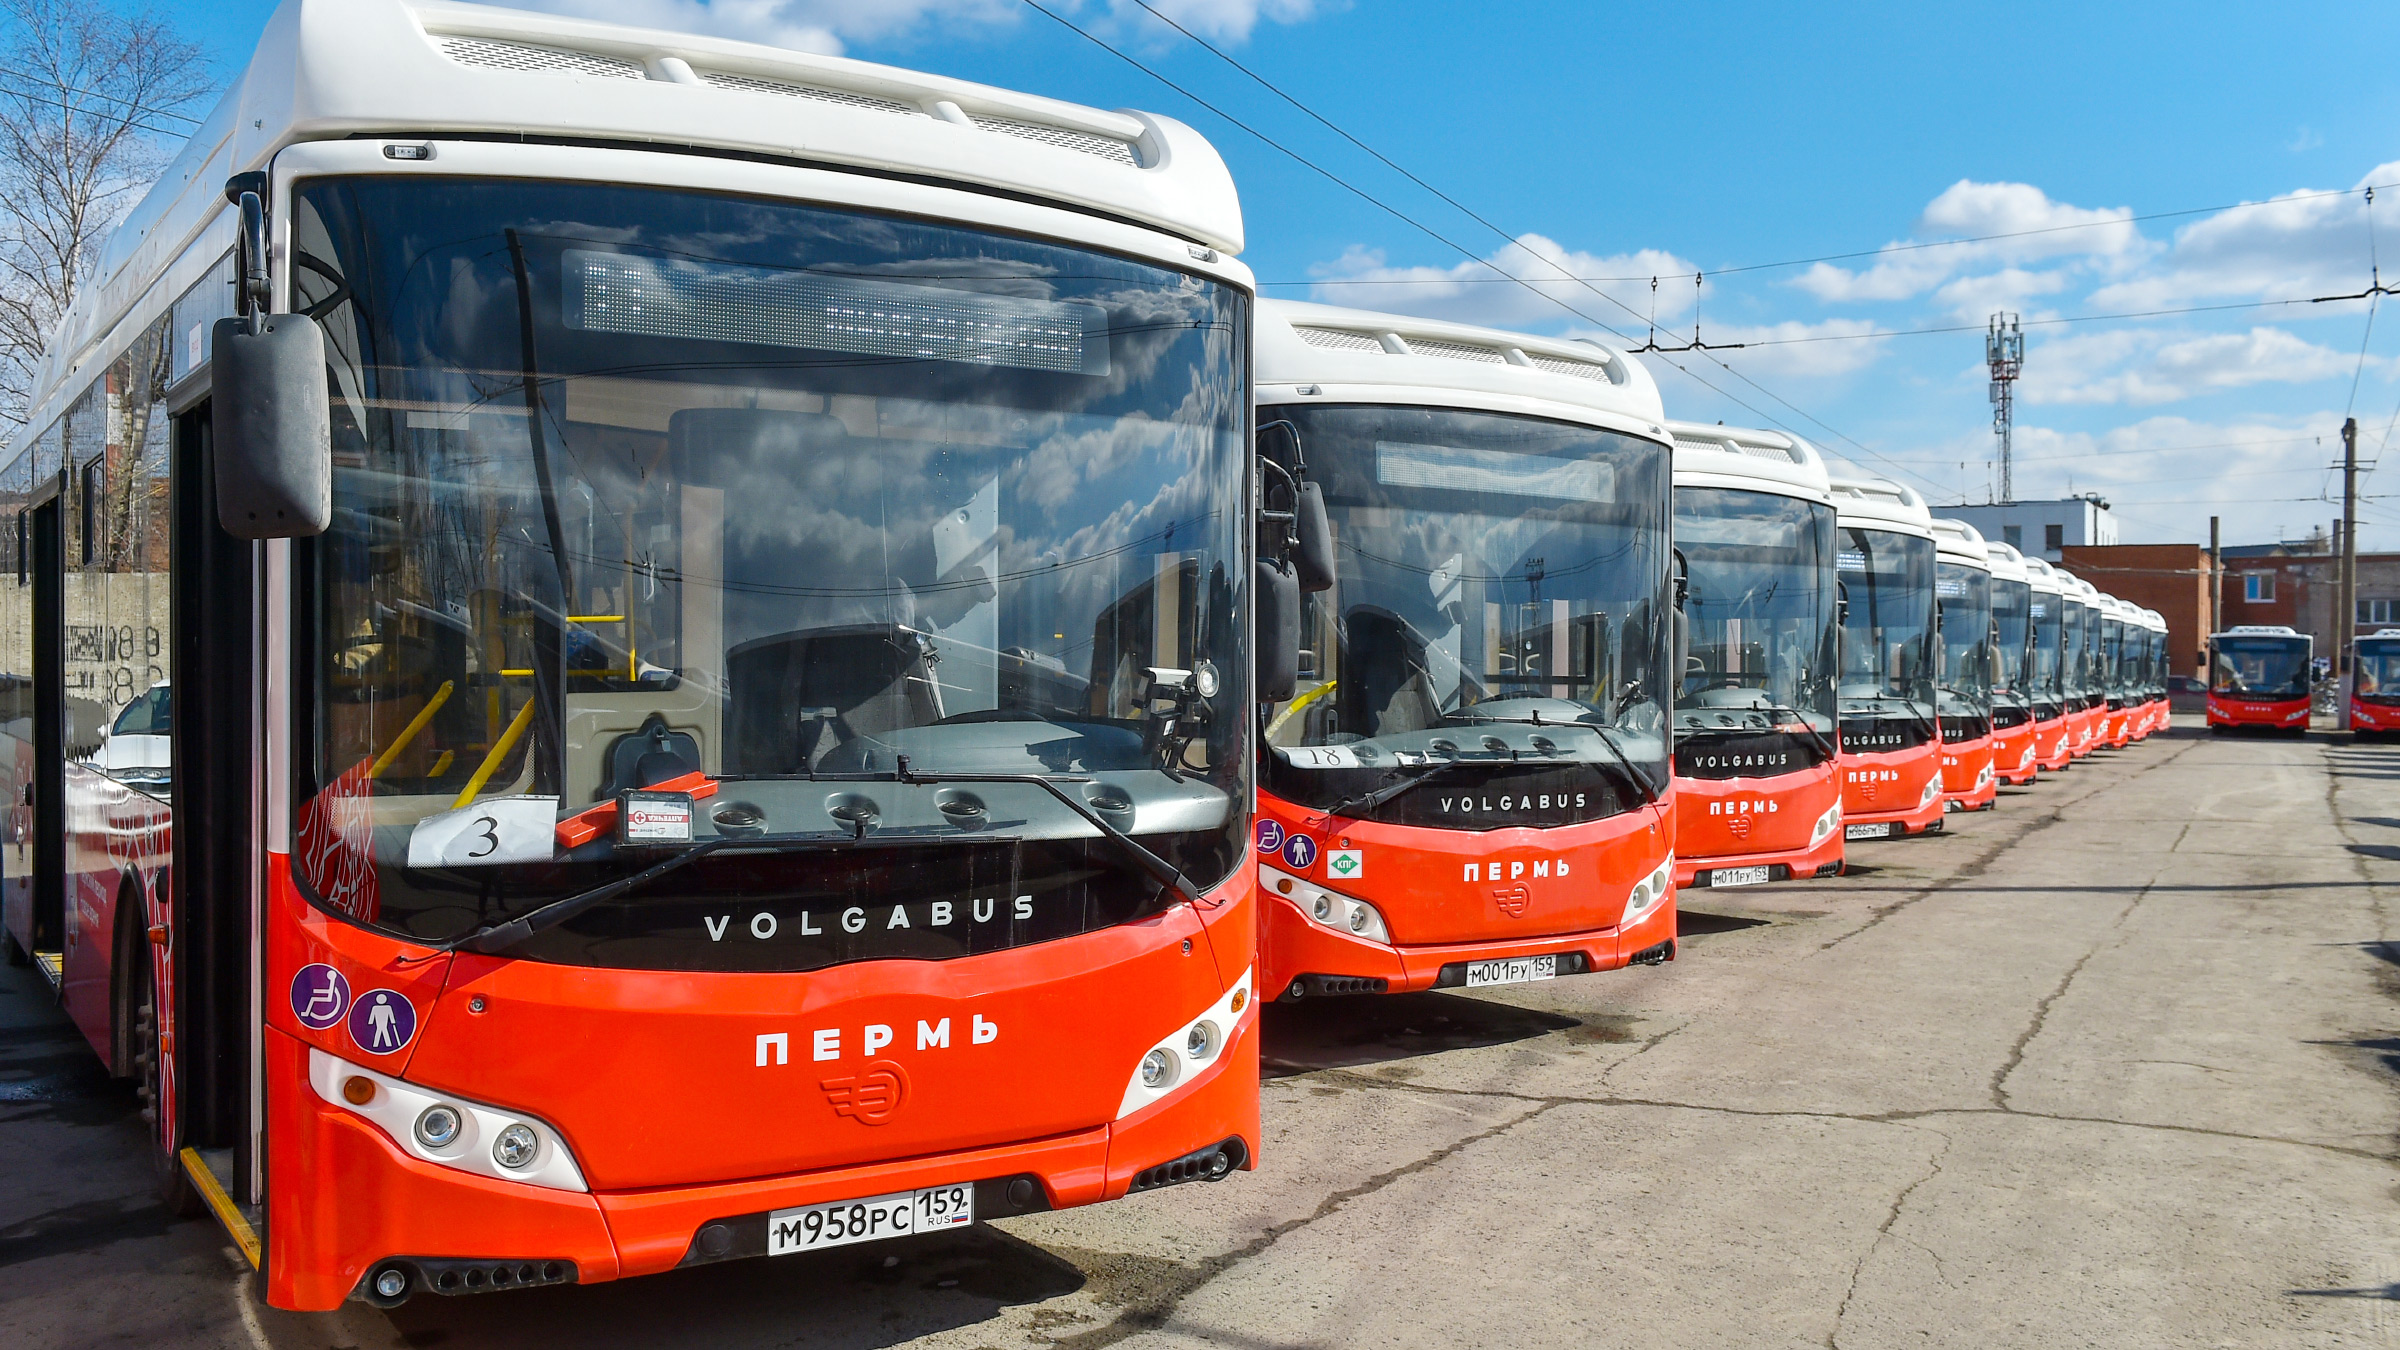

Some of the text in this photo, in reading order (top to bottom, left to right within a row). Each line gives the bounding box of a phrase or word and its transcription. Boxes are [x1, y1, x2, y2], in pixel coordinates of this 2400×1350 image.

[1843, 735, 1902, 746] OLGABUS
[1309, 748, 1341, 766] 18
[1694, 753, 1788, 768] VOLGABUS
[1848, 769, 1899, 783] ПЕРМЬ
[1440, 792, 1587, 813] VOLGABUS
[1709, 799, 1779, 816] ПЕРМЬ
[467, 816, 500, 858] 3
[1337, 860, 1353, 869] КПГ
[1463, 858, 1570, 883] ПЕРМЬ
[1714, 866, 1767, 884] М011РУ 159
[703, 894, 1034, 942] VOLGABUS
[1471, 956, 1553, 983] М001РУ 159
[754, 1013, 998, 1068] ПЕРМЬ
[779, 1187, 966, 1249] М958РС 159
[927, 1214, 952, 1226] RUS
